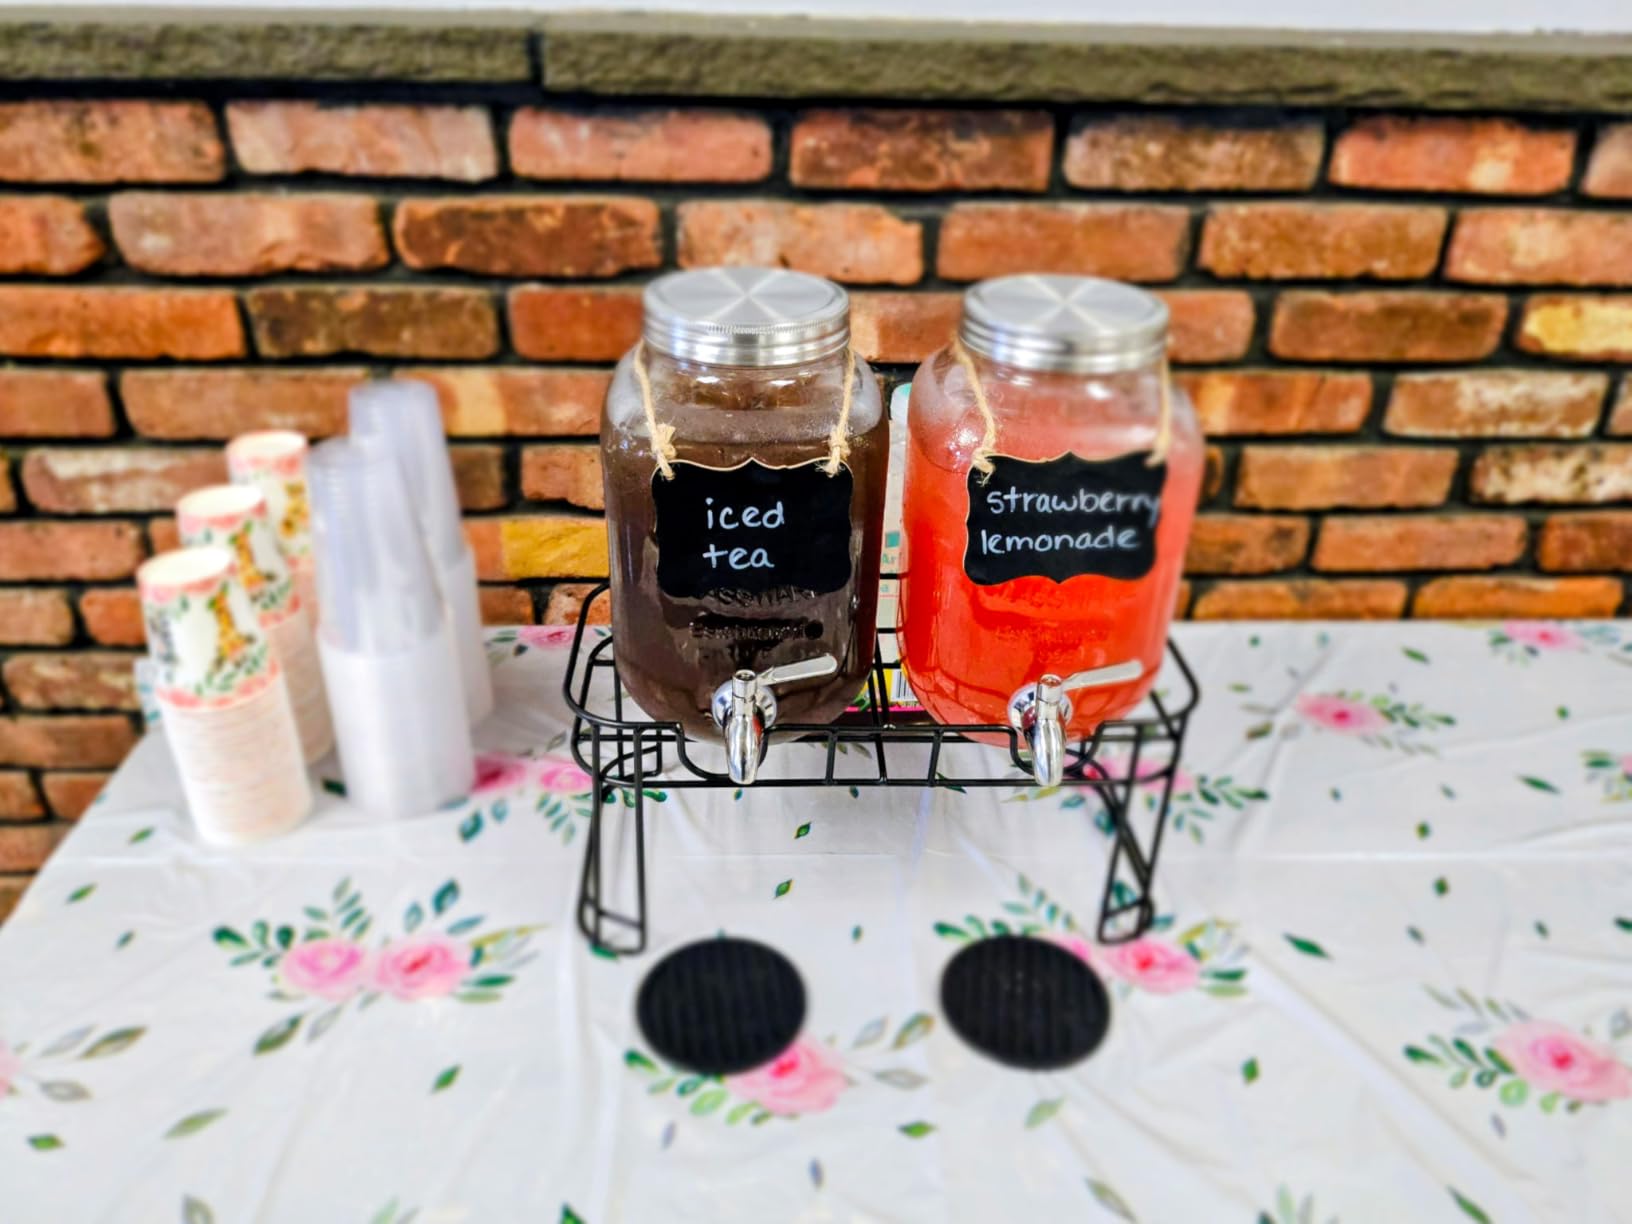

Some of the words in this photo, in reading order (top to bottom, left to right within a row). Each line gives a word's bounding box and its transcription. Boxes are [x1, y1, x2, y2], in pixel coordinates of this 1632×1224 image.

[704, 497, 785, 529] iced
[986, 485, 1161, 528] strawberry
[980, 524, 1138, 555] lemonade
[702, 543, 776, 570] tea
